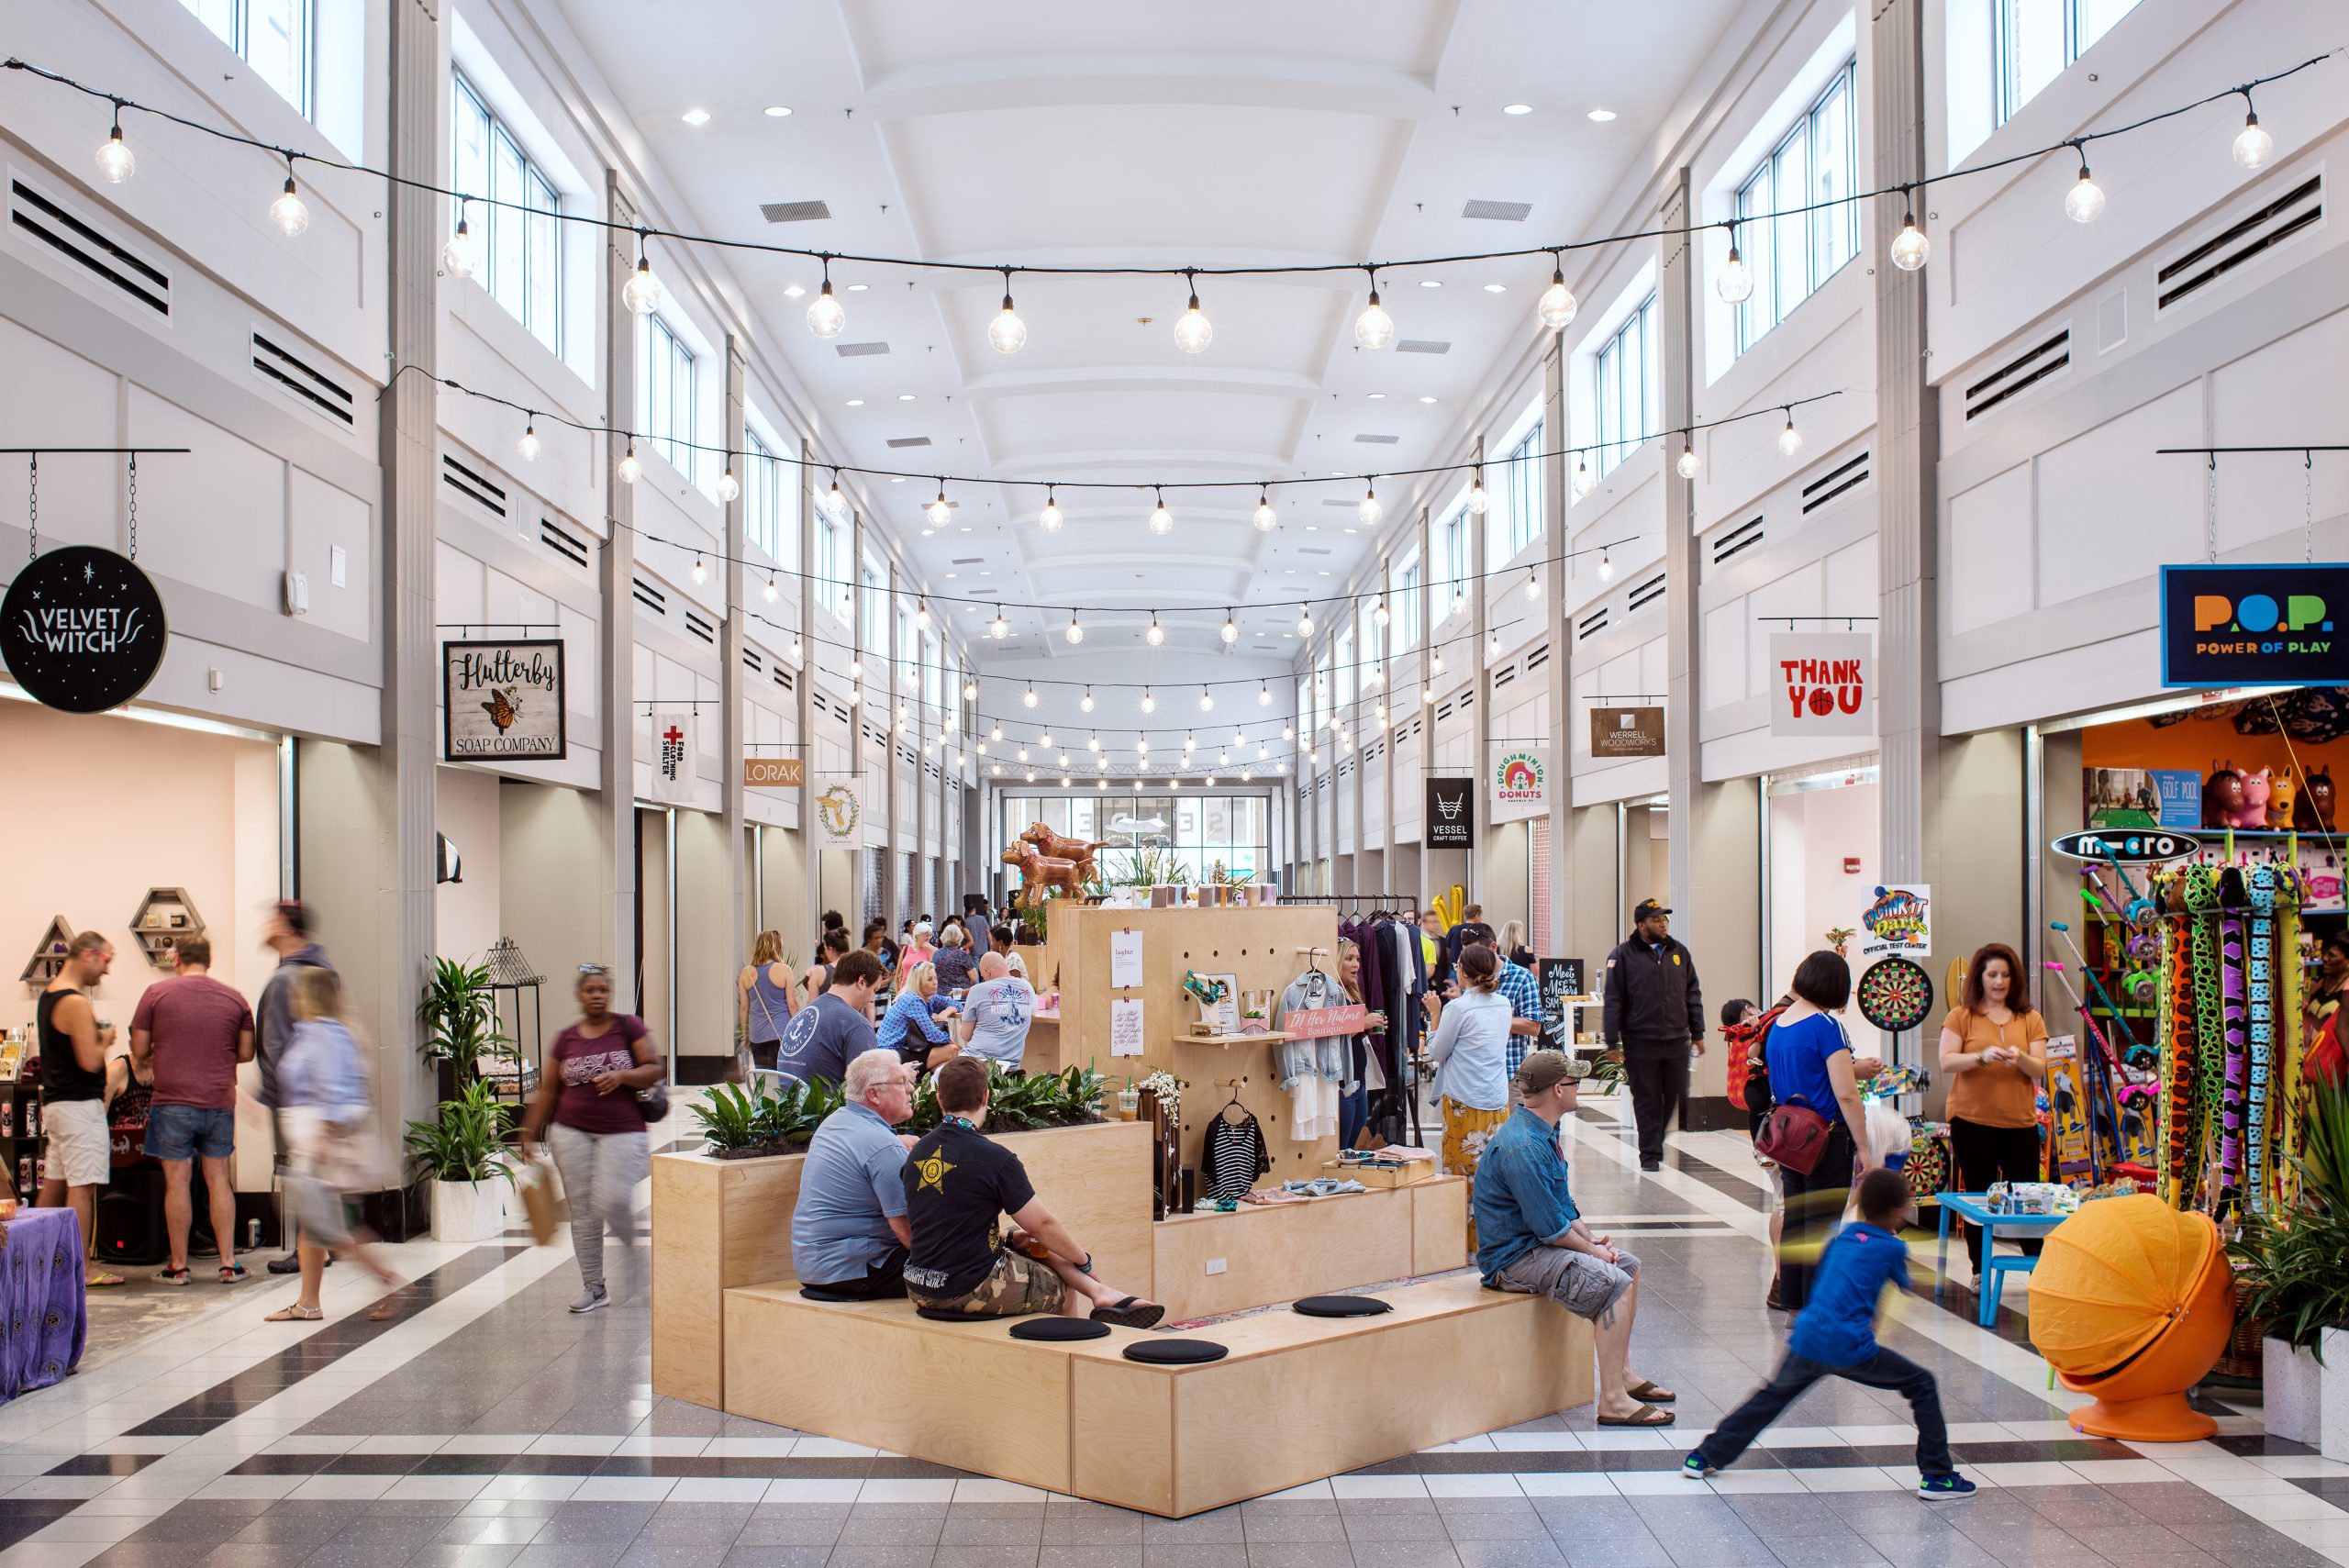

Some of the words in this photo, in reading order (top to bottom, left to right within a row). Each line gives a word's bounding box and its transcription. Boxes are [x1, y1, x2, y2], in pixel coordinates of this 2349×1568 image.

[39, 607, 121, 629] VELVET
[44, 630, 116, 653] WITCH
[2196, 642, 2258, 655] POWER
[2261, 641, 2283, 654] OF
[2288, 641, 2332, 653] PLAY
[451, 649, 556, 692] Flutterby
[1780, 659, 1864, 684] THANK
[1788, 685, 1863, 717] YOU
[1600, 738, 1657, 747] WOODWORKS
[1609, 730, 1647, 739] WERRELL
[456, 738, 491, 752] SOAP
[494, 737, 555, 751] COMPANY
[746, 765, 800, 781] LORAK
[1497, 752, 1543, 784] DOUGHMINION
[1498, 790, 1542, 799] DONUTS
[2163, 781, 2179, 799] GOLF
[2182, 781, 2199, 800] POOL
[1432, 825, 1468, 834] VESSEL
[1874, 917, 1929, 940] Darts
[1863, 943, 1888, 955] OFFICIAL
[1548, 963, 1575, 979] Meet
[1543, 978, 1578, 997] Makers
[1545, 996, 1560, 1008] SAM
[1307, 1011, 1325, 1027] Her
[1328, 1007, 1362, 1026] Nature
[1308, 1025, 1343, 1036] Boutique
